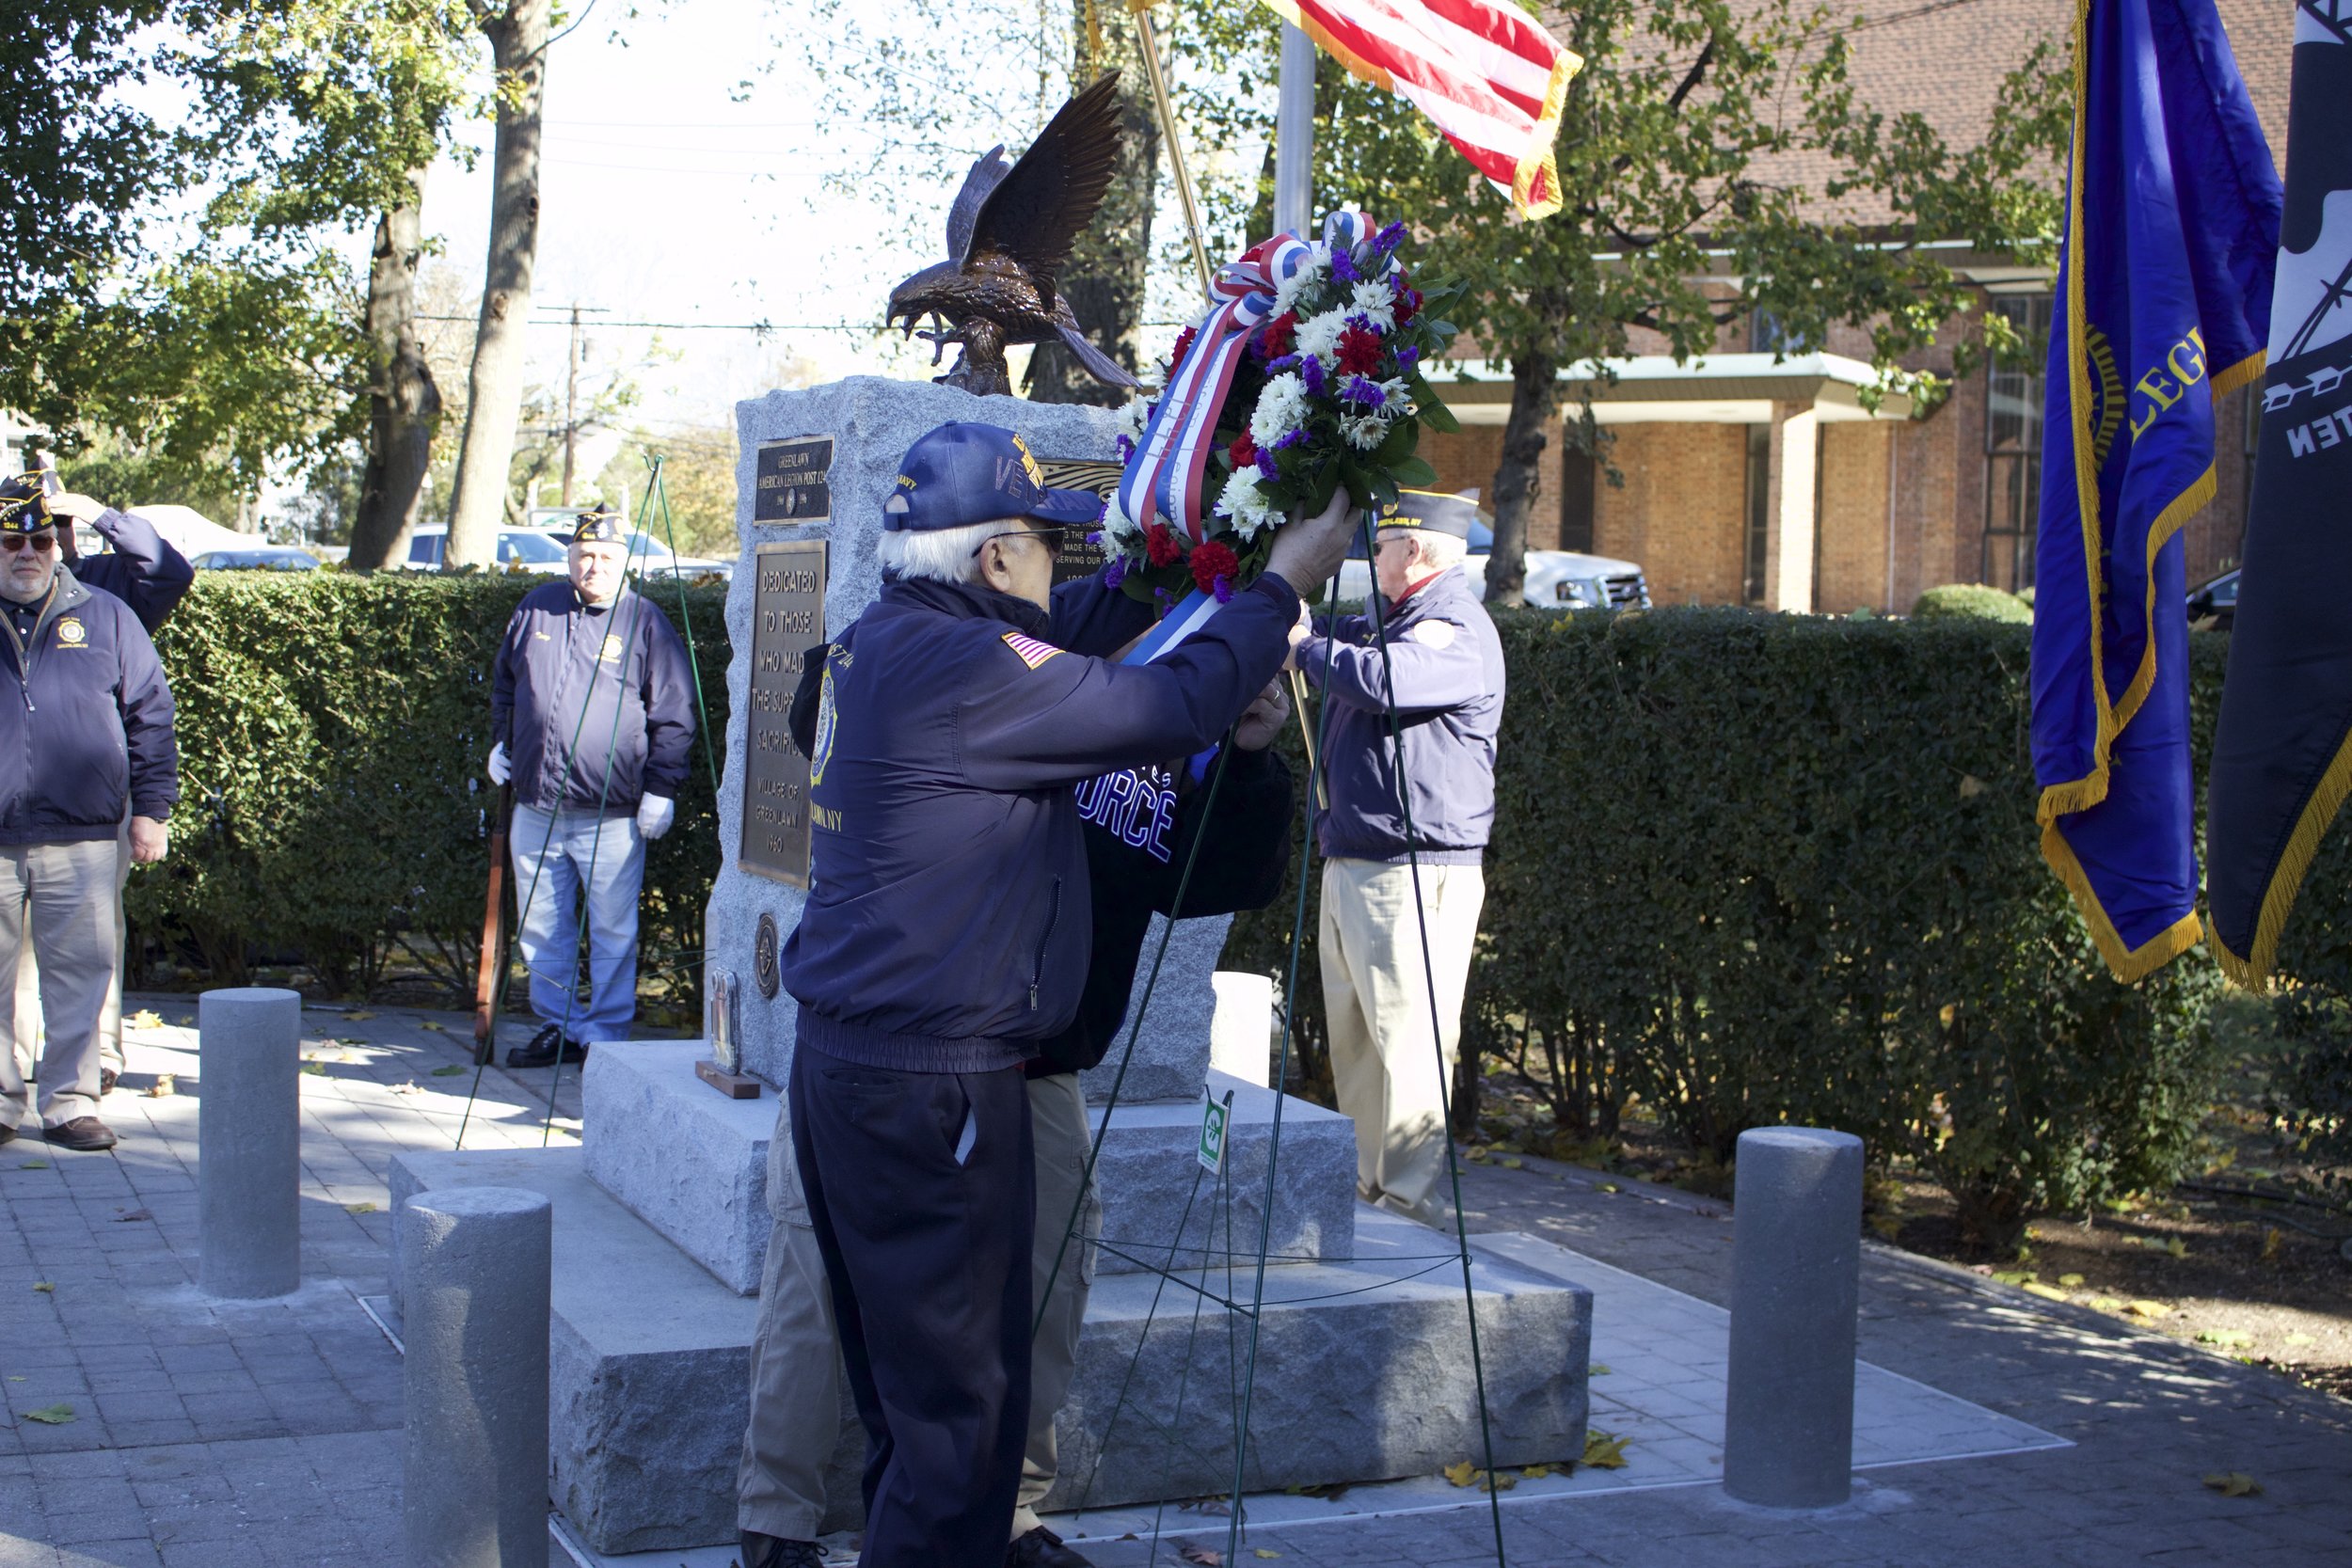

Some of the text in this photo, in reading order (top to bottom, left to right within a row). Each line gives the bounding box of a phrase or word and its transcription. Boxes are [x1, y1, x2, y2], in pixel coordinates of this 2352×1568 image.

[778, 452, 810, 468] GREENLAWN
[758, 474, 784, 489] AMERICAN
[785, 472, 803, 487] LEGION
[803, 471, 817, 485] POST
[1071, 531, 1085, 540] THE
[1064, 543, 1083, 552] MADE
[1085, 544, 1097, 553] THE
[1087, 557, 1101, 565] OUR
[762, 570, 816, 594] DEDICATED
[764, 610, 812, 634] TO THOSE
[760, 650, 780, 673] WHO
[752, 688, 770, 711] THE
[757, 777, 800, 800] VILLAGE OF
[755, 804, 798, 829] GREENLAWN
[827, 809, 842, 832] NY
[767, 834, 784, 853] 1960
